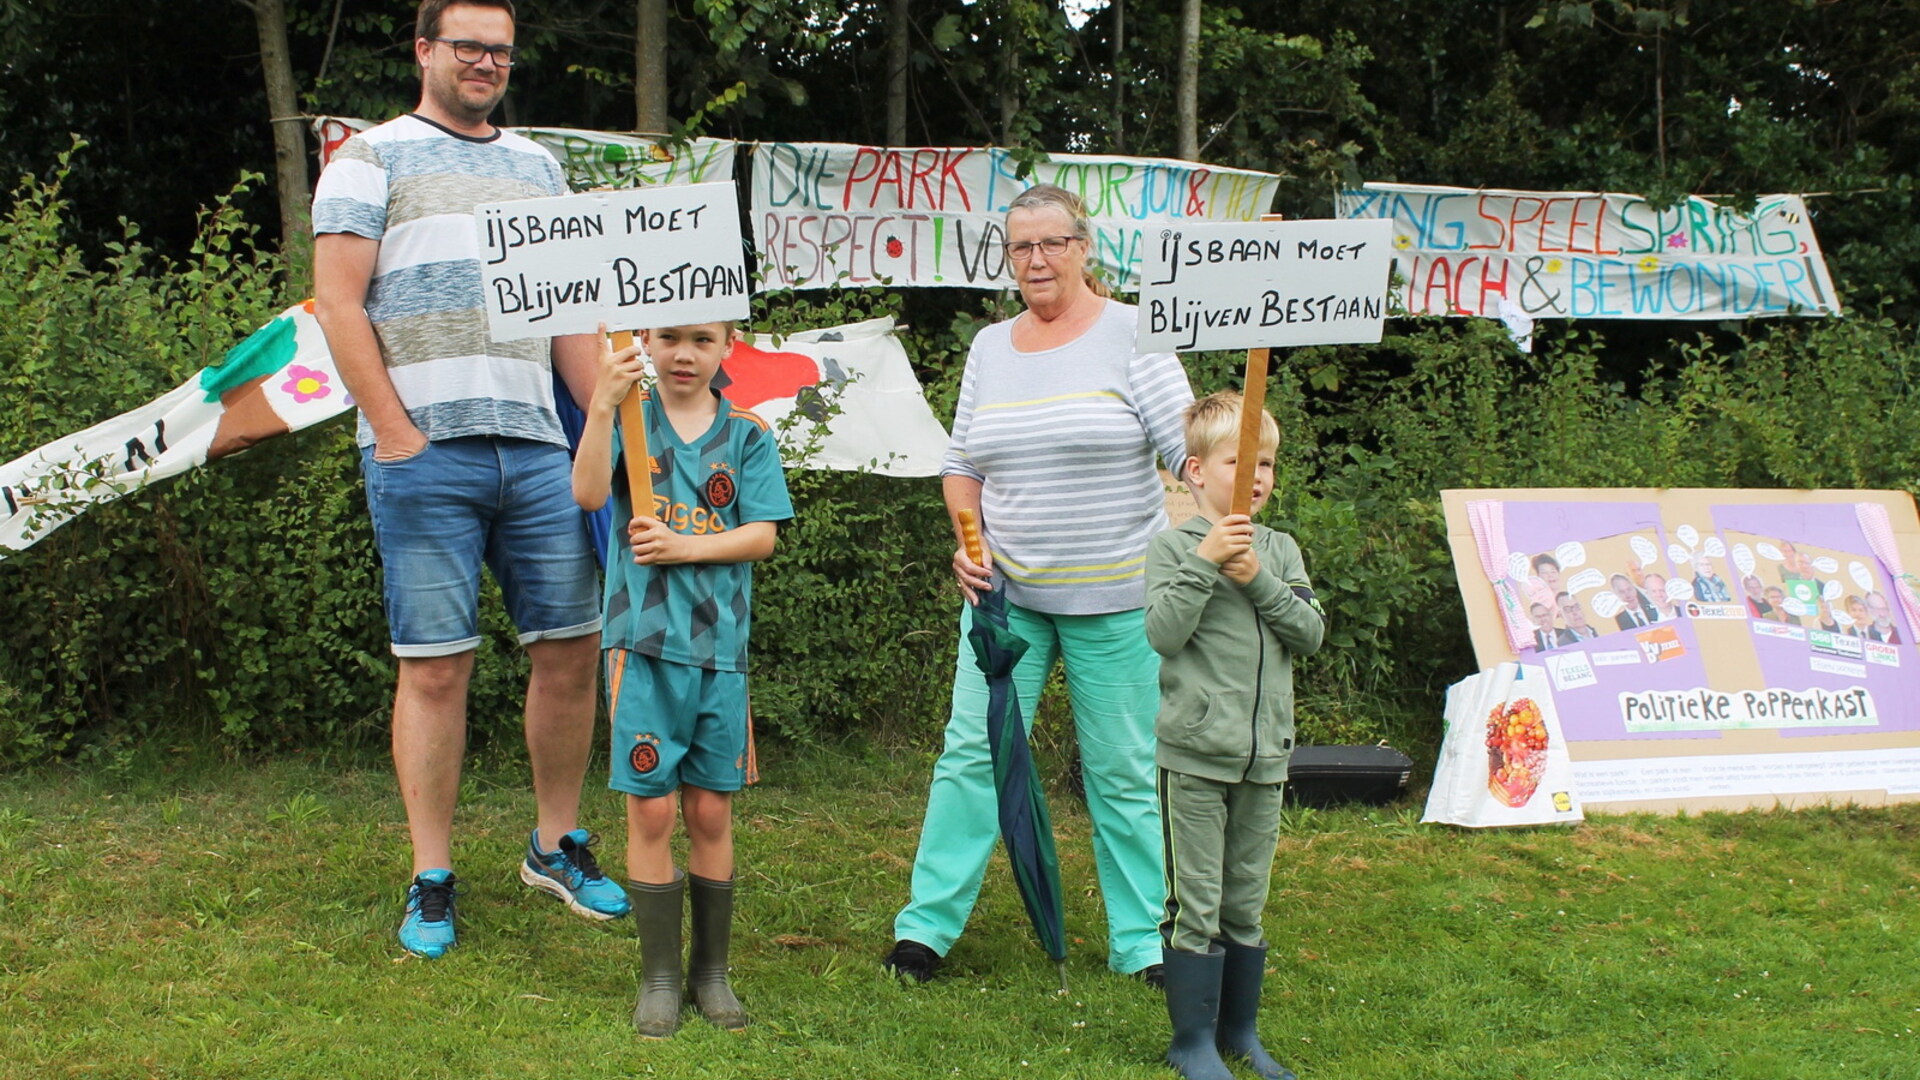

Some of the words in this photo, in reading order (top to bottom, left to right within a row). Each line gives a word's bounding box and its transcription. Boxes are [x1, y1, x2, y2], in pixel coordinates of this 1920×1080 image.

[842, 147, 974, 213] PARK
[1130, 163, 1192, 220] JOU
[1186, 168, 1211, 217] &
[625, 203, 707, 233] MOET
[1468, 195, 1626, 256] SPEEL,
[764, 213, 945, 283] RESPECT!
[1297, 238, 1367, 262] MOET
[613, 256, 745, 307] BESTAAN
[1408, 256, 1509, 317] LACH
[1519, 255, 1567, 315] &
[1571, 257, 1829, 317] BEWONDER!
[1259, 289, 1387, 328] BESTAAN
[1833, 633, 1861, 649] Texel
[1865, 642, 1898, 656] GROEN
